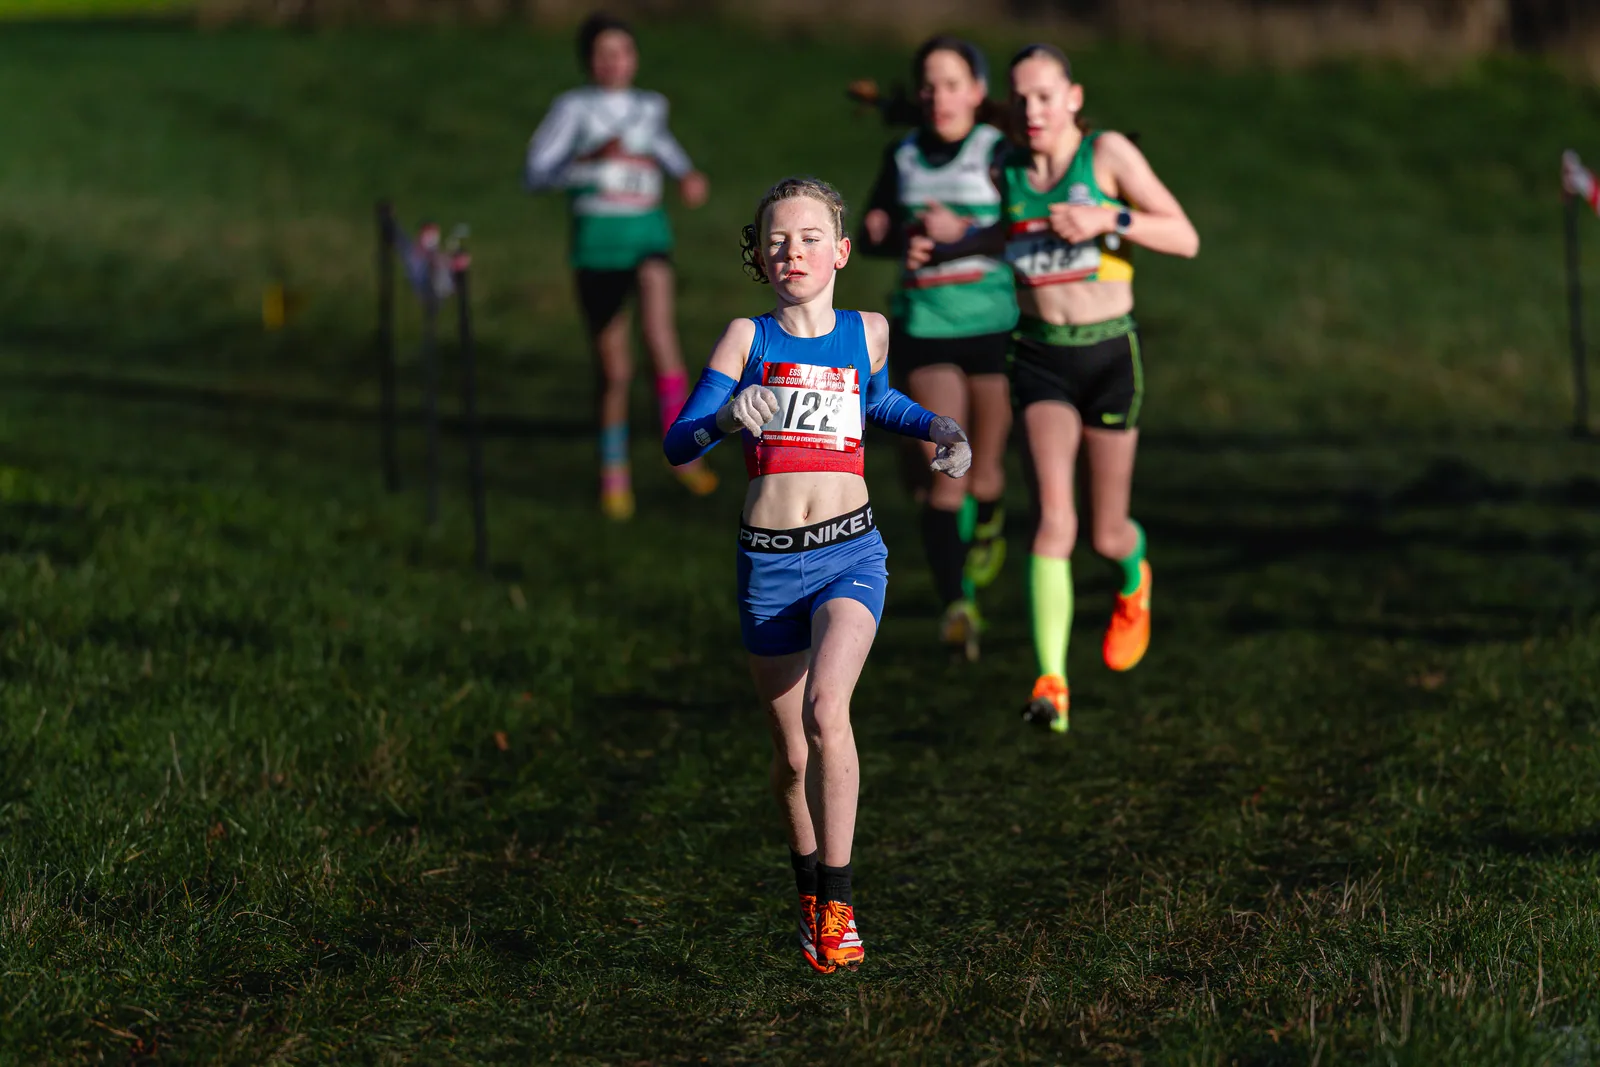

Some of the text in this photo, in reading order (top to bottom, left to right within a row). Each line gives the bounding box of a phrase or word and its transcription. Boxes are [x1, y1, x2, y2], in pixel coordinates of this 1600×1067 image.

[768, 376, 785, 384] CROSS
[740, 528, 794, 549] PRO
[803, 512, 866, 547] NIKE
